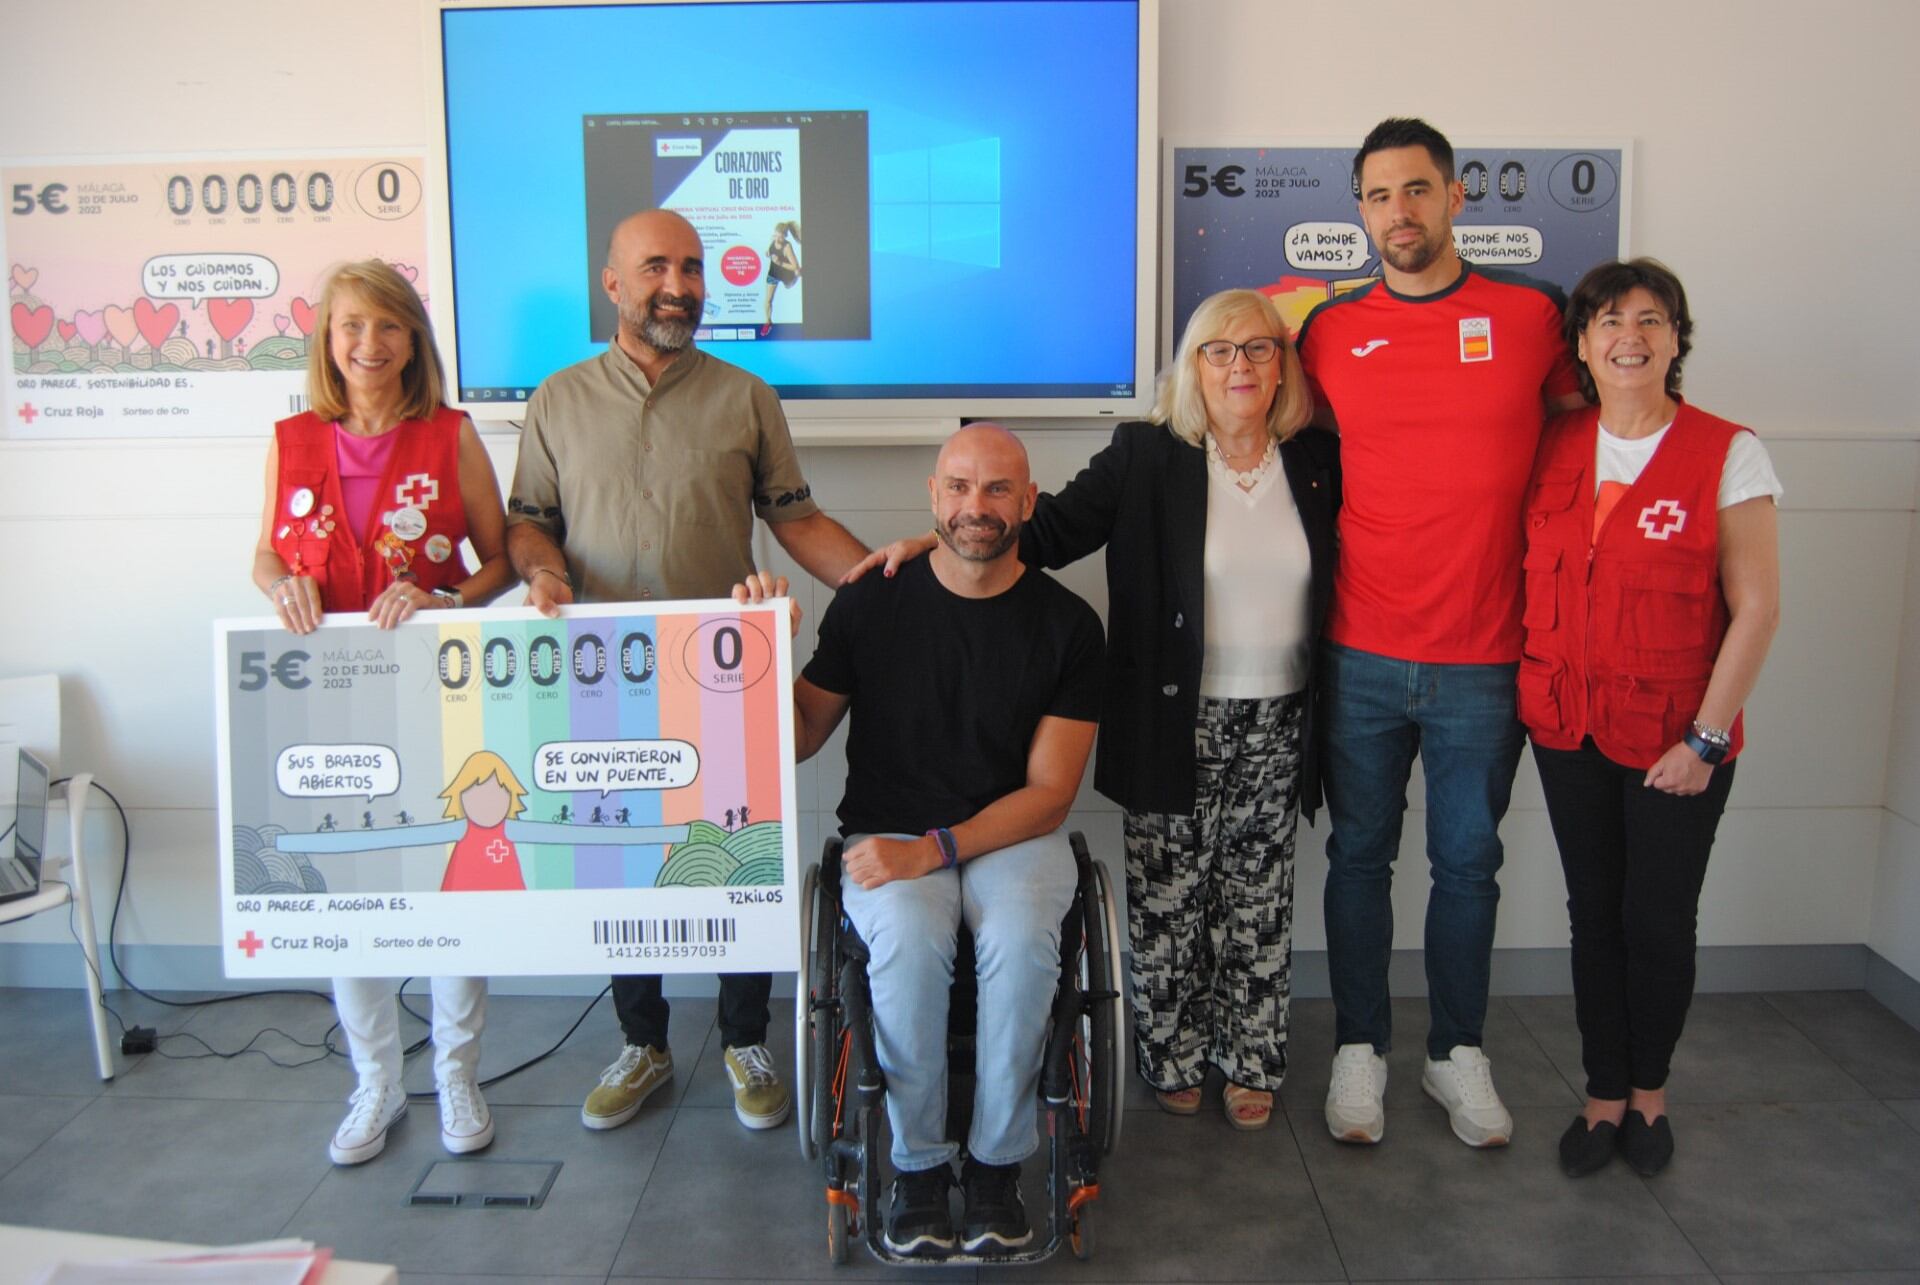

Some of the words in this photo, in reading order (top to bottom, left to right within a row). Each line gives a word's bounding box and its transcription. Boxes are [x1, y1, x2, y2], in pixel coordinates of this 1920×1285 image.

[714, 151, 783, 173] CORAZONES
[1255, 165, 1308, 177] MÁLAGA
[1571, 159, 1596, 196] 0
[377, 168, 401, 204] 0
[1183, 165, 1246, 198] 5€
[1255, 179, 1268, 188] 20
[1271, 179, 1287, 188] DE
[1289, 179, 1320, 188] JULIO
[77, 183, 126, 194] MÁLAGA
[729, 178, 744, 200] DE
[746, 177, 770, 199] ORO
[1255, 189, 1281, 198] 2023
[12, 182, 70, 216] 5€
[78, 195, 90, 204] 20
[93, 195, 107, 204] DE
[109, 194, 139, 204] JULIO
[1570, 196, 1595, 205] SERIE
[78, 206, 102, 215] 2023
[377, 206, 402, 215] SERIE
[1462, 232, 1500, 244] DONDE
[1506, 232, 1529, 243] NOS
[1296, 250, 1354, 267] VAMOS?
[151, 264, 177, 277] LOS
[185, 262, 254, 277] CUIDAMOS
[158, 281, 167, 293] Y
[177, 280, 206, 292] NOS
[17, 379, 36, 389] ORO
[87, 377, 171, 389] SOSTENIBILIDAD
[44, 406, 73, 417] Cruz
[76, 405, 105, 419] Roja
[122, 407, 154, 416] Sorteo
[156, 406, 169, 416] de
[171, 406, 190, 416] Oro
[713, 626, 743, 670] 0
[323, 649, 384, 662] MÁLAGA
[238, 649, 312, 692] 5€
[323, 666, 338, 677] 20
[342, 665, 359, 676] DE
[363, 664, 400, 676] JULIO
[323, 678, 353, 689] 2023
[713, 673, 745, 684] SERIE
[446, 694, 468, 703] CERO
[490, 693, 513, 701] CERO
[536, 691, 558, 700] CERO
[580, 690, 603, 698] CERO
[628, 688, 651, 697] CERO
[288, 754, 315, 770] SUS
[325, 754, 382, 769] BRAZOS
[545, 750, 564, 767] SE
[571, 746, 682, 765] CONVIRTIERON
[298, 774, 373, 791] ABIERTOS
[545, 770, 568, 784] EN
[576, 770, 599, 783] UN
[607, 768, 675, 784] PUENTE.
[726, 889, 784, 905] 72KILOS
[236, 900, 261, 912] ORO
[327, 897, 384, 912] ACOGIDA
[390, 898, 414, 911] ES.
[271, 936, 308, 949] Cruz
[313, 935, 349, 951] Roja
[373, 937, 414, 949] Sorteo
[417, 937, 433, 948] de
[437, 936, 461, 948] Oro
[607, 945, 727, 958] 1412632597093
